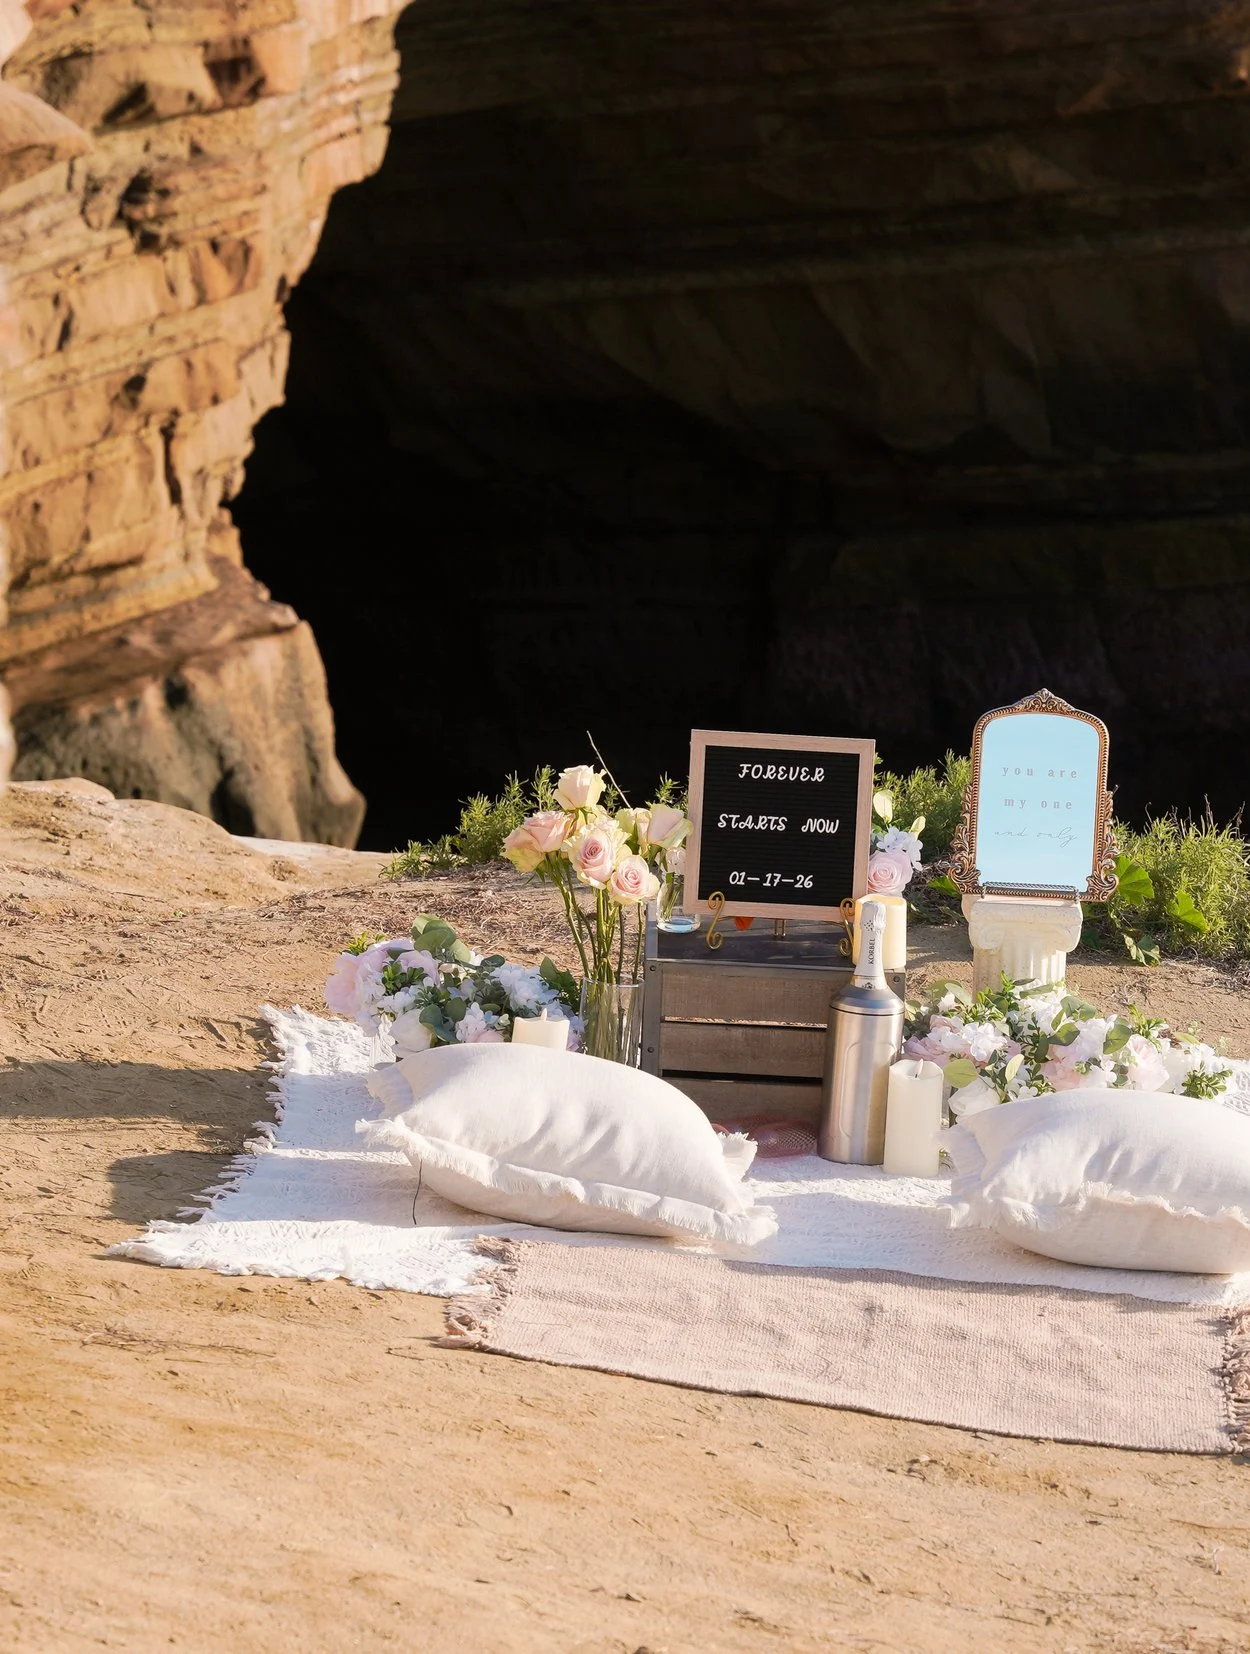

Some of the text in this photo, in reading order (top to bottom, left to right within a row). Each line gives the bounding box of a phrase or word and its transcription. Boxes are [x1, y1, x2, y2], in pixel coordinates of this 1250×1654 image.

[738, 763, 825, 782] FOREVER
[1003, 767, 1078, 779] you are
[1004, 797, 1072, 810] my one
[717, 813, 839, 834] STARTS NOW
[868, 938, 876, 965] KORBEL
